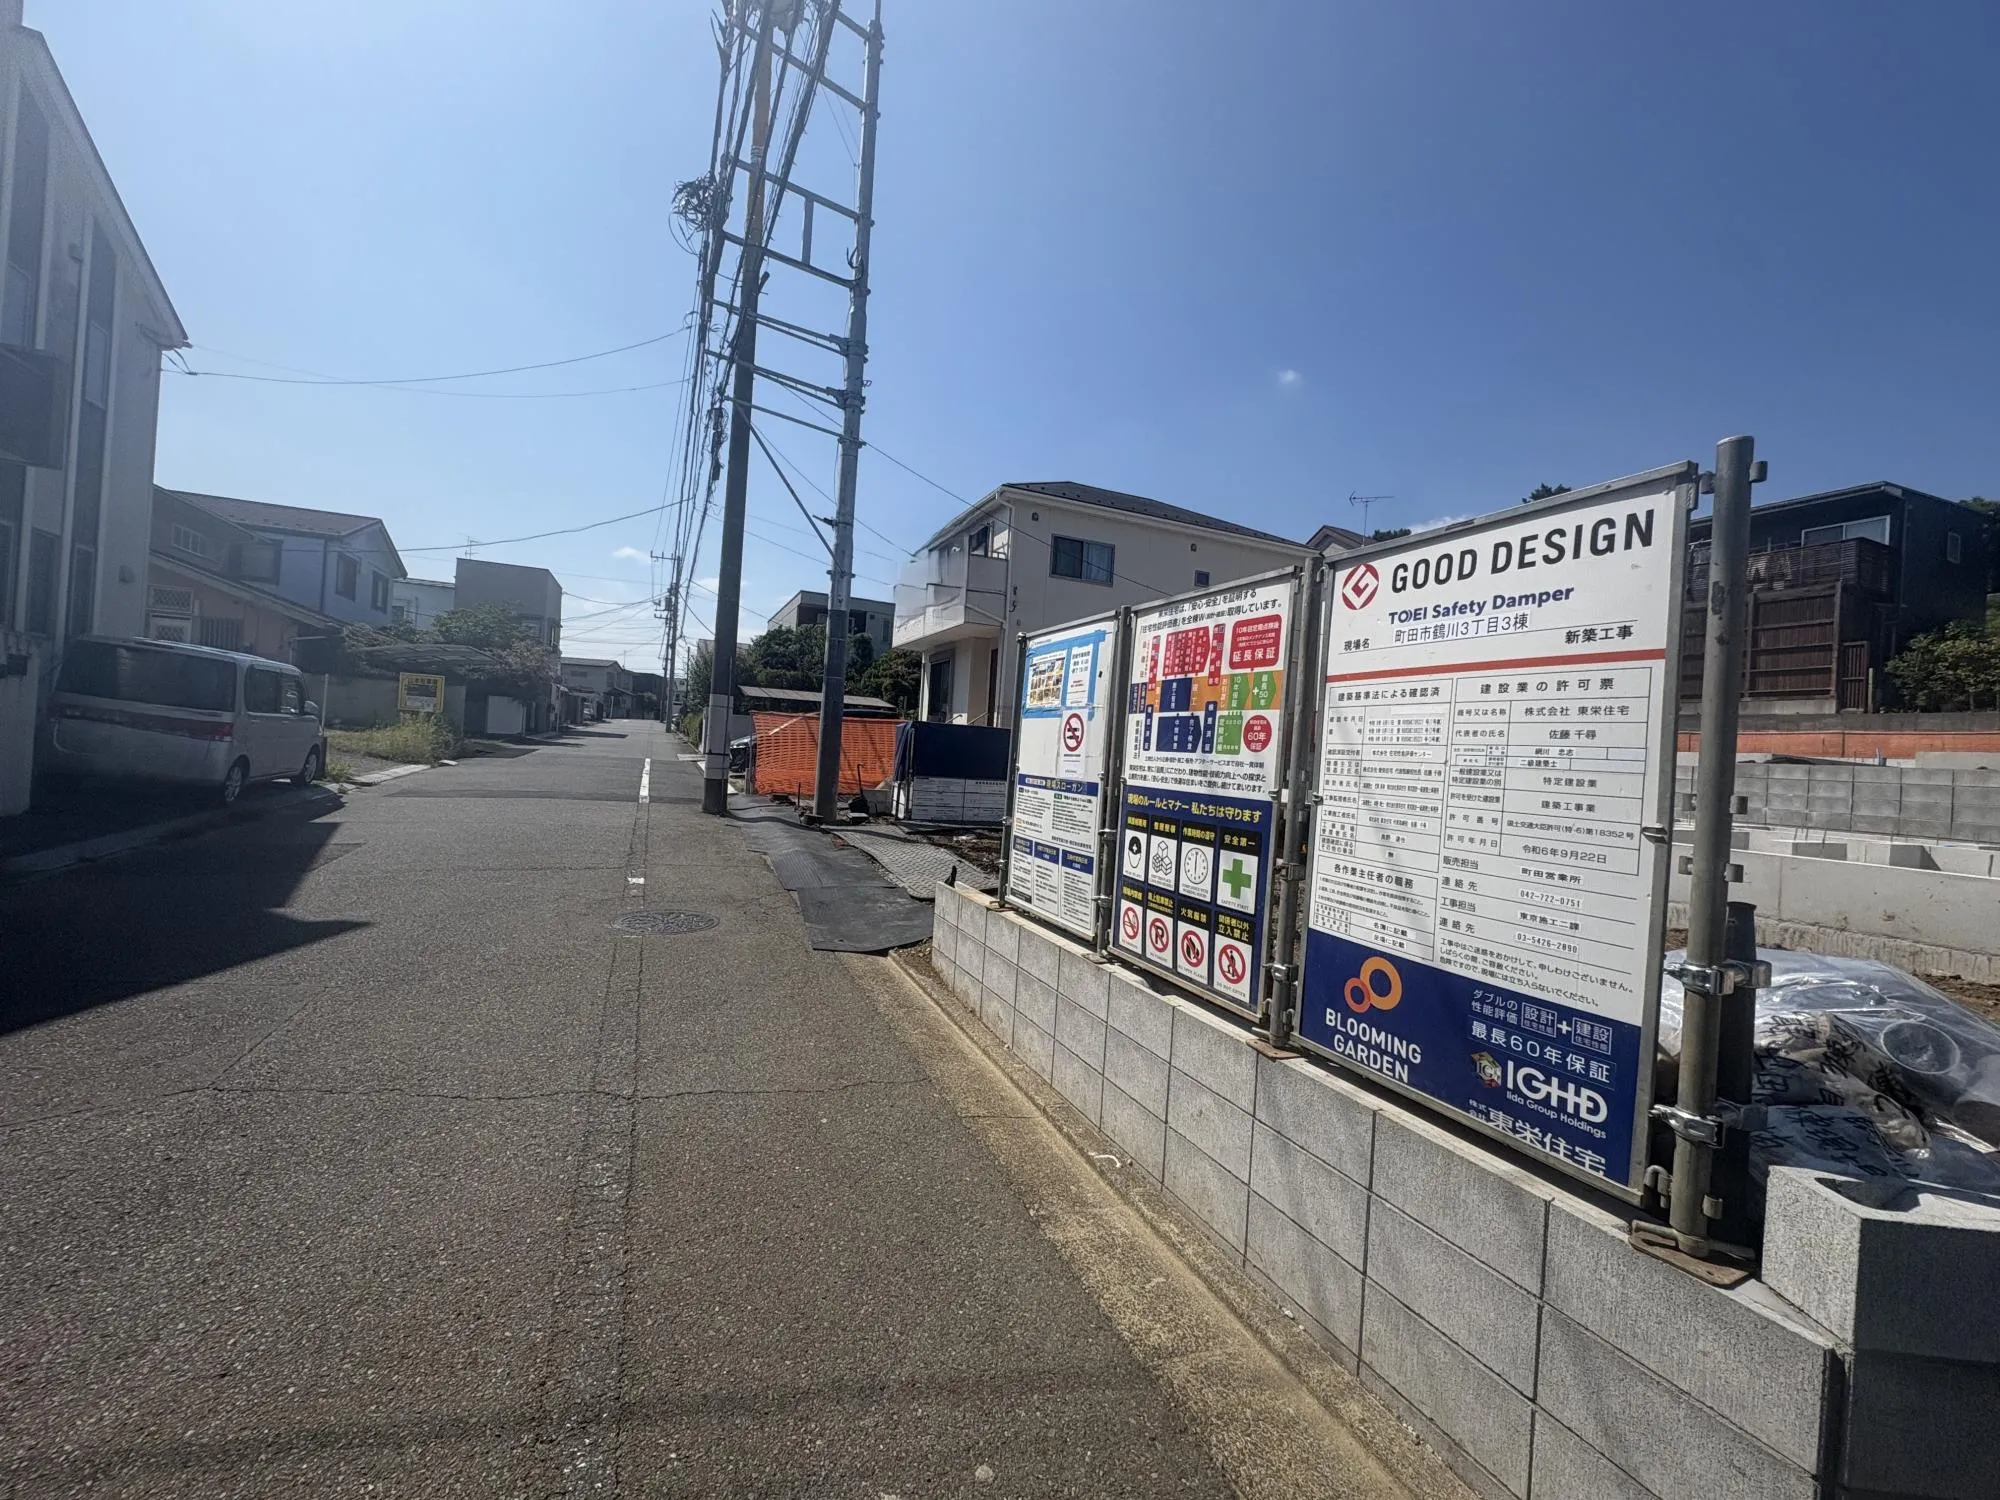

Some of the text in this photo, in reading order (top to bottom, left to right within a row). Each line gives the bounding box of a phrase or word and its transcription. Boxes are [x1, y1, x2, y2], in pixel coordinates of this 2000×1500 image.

[1392, 509, 1655, 593] GOOD DESIGN
[1432, 599, 1487, 618] Safety
[1492, 587, 1574, 609] Damper
[1394, 612, 1529, 644] 町田市鶴川3丁目3棟
[1565, 624, 1634, 644] 新築工事
[1343, 638, 1370, 651] 現場名
[1233, 646, 1276, 662] 延長保証
[1480, 678, 1615, 695] 建設業の許可票
[1524, 705, 1630, 717] 株式会社 東栄住宅
[1455, 729, 1505, 738] 代表者の氏名
[1549, 729, 1570, 740] 佐藤
[1543, 776, 1598, 788] 特定建設業
[1191, 801, 1262, 824] 私たちは守ります
[1541, 800, 1596, 813] 建築工事業
[1449, 813, 1499, 826] 許可番号
[1224, 834, 1256, 847] 安全第一
[1447, 834, 1498, 848] 許可年月日
[1443, 855, 1478, 870] 販売担当
[1522, 844, 1607, 864] 令和6年9月22日
[1333, 863, 1414, 889] 各作業主任者の職務
[1441, 876, 1478, 892] 連絡先
[1521, 867, 1581, 884] 町田営業所
[1441, 896, 1476, 912] 工事担当
[1520, 890, 1580, 908] 042-722-0751
[1218, 925, 1249, 942] 立入禁止
[1439, 917, 1475, 934] 連絡先
[1517, 933, 1578, 954] 03-5426-2890
[1473, 989, 1518, 1011] ダブルの
[1471, 1001, 1518, 1025] 性能評価
[1525, 1006, 1554, 1026] 設計
[1325, 1007, 1422, 1064] BLOOMING
[1576, 1021, 1609, 1044] 建設
[1333, 1034, 1409, 1084] GARDEN
[1471, 1020, 1611, 1084] 最長60年保証
[1526, 1099, 1558, 1120] Group
[1560, 1112, 1607, 1139] Holdings
[1486, 1107, 1607, 1177] 東栄住宅
